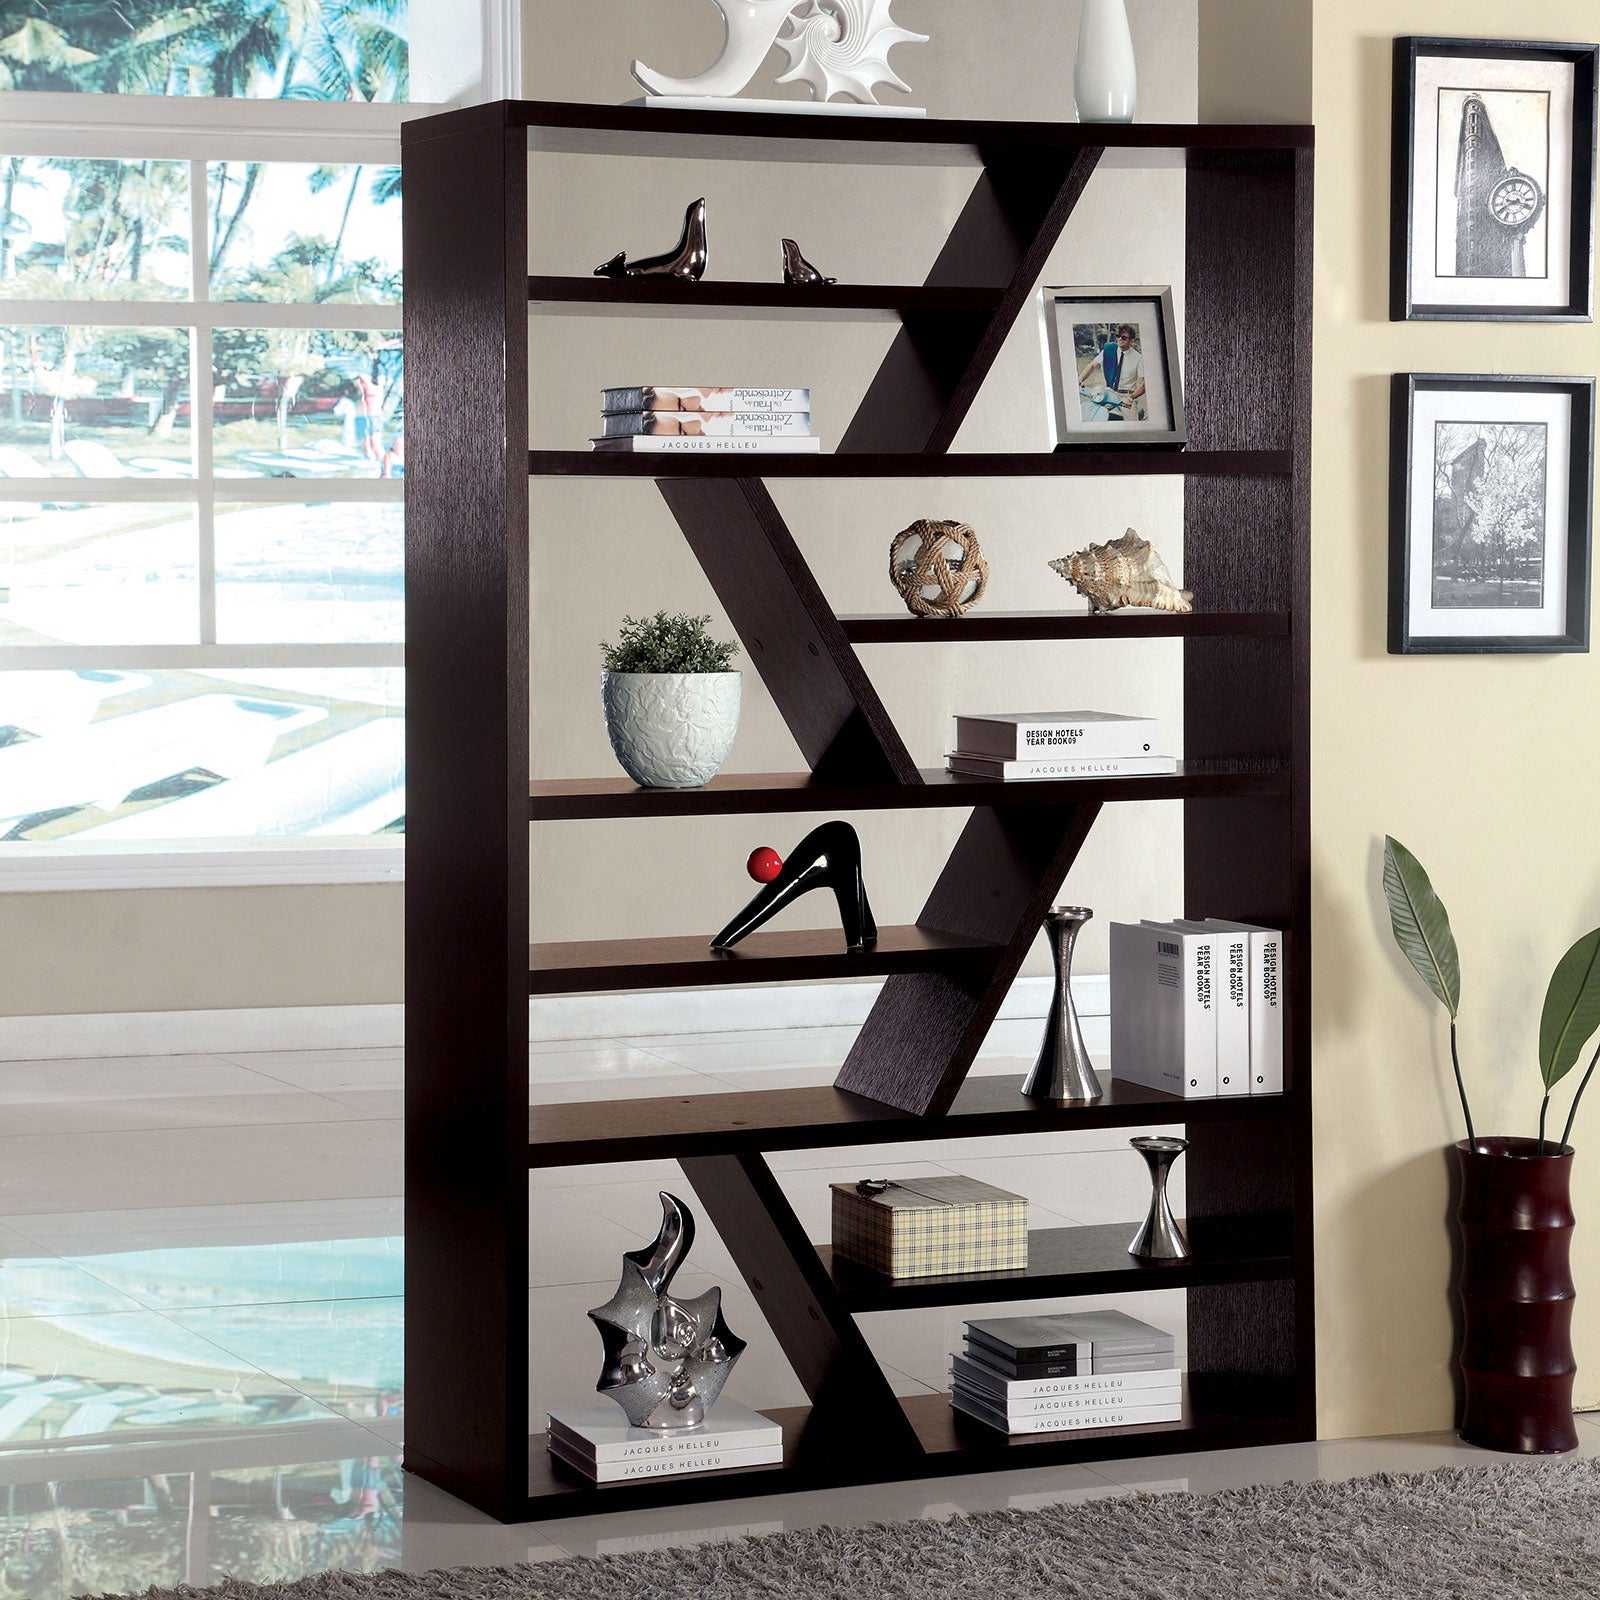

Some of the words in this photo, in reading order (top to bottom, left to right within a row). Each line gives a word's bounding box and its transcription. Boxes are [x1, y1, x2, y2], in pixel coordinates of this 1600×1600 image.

[733, 390, 792, 401] Zeitreisender
[754, 401, 773, 411] Frau
[734, 414, 792, 425] Zeitreisender
[754, 425, 773, 435] Frau
[1026, 729, 1053, 738] DESIGN
[1026, 737, 1045, 746] YEAR
[1047, 737, 1077, 745] BOOK09
[1030, 765, 1076, 774] JACQUES
[1080, 764, 1119, 772] HELLEU
[1033, 1383, 1080, 1393] JACQUES
[1084, 1380, 1123, 1389] HELLEU
[1034, 1400, 1080, 1410] JACQUES
[1085, 1397, 1124, 1406] HELLEU
[1034, 1418, 1081, 1428] JACQUES
[1085, 1415, 1124, 1424] HELLEU
[623, 1445, 674, 1456] JACQUES
[678, 1440, 720, 1450] HELLEU
[624, 1462, 674, 1475] JACQUES
[679, 1458, 721, 1468] HELLEU
